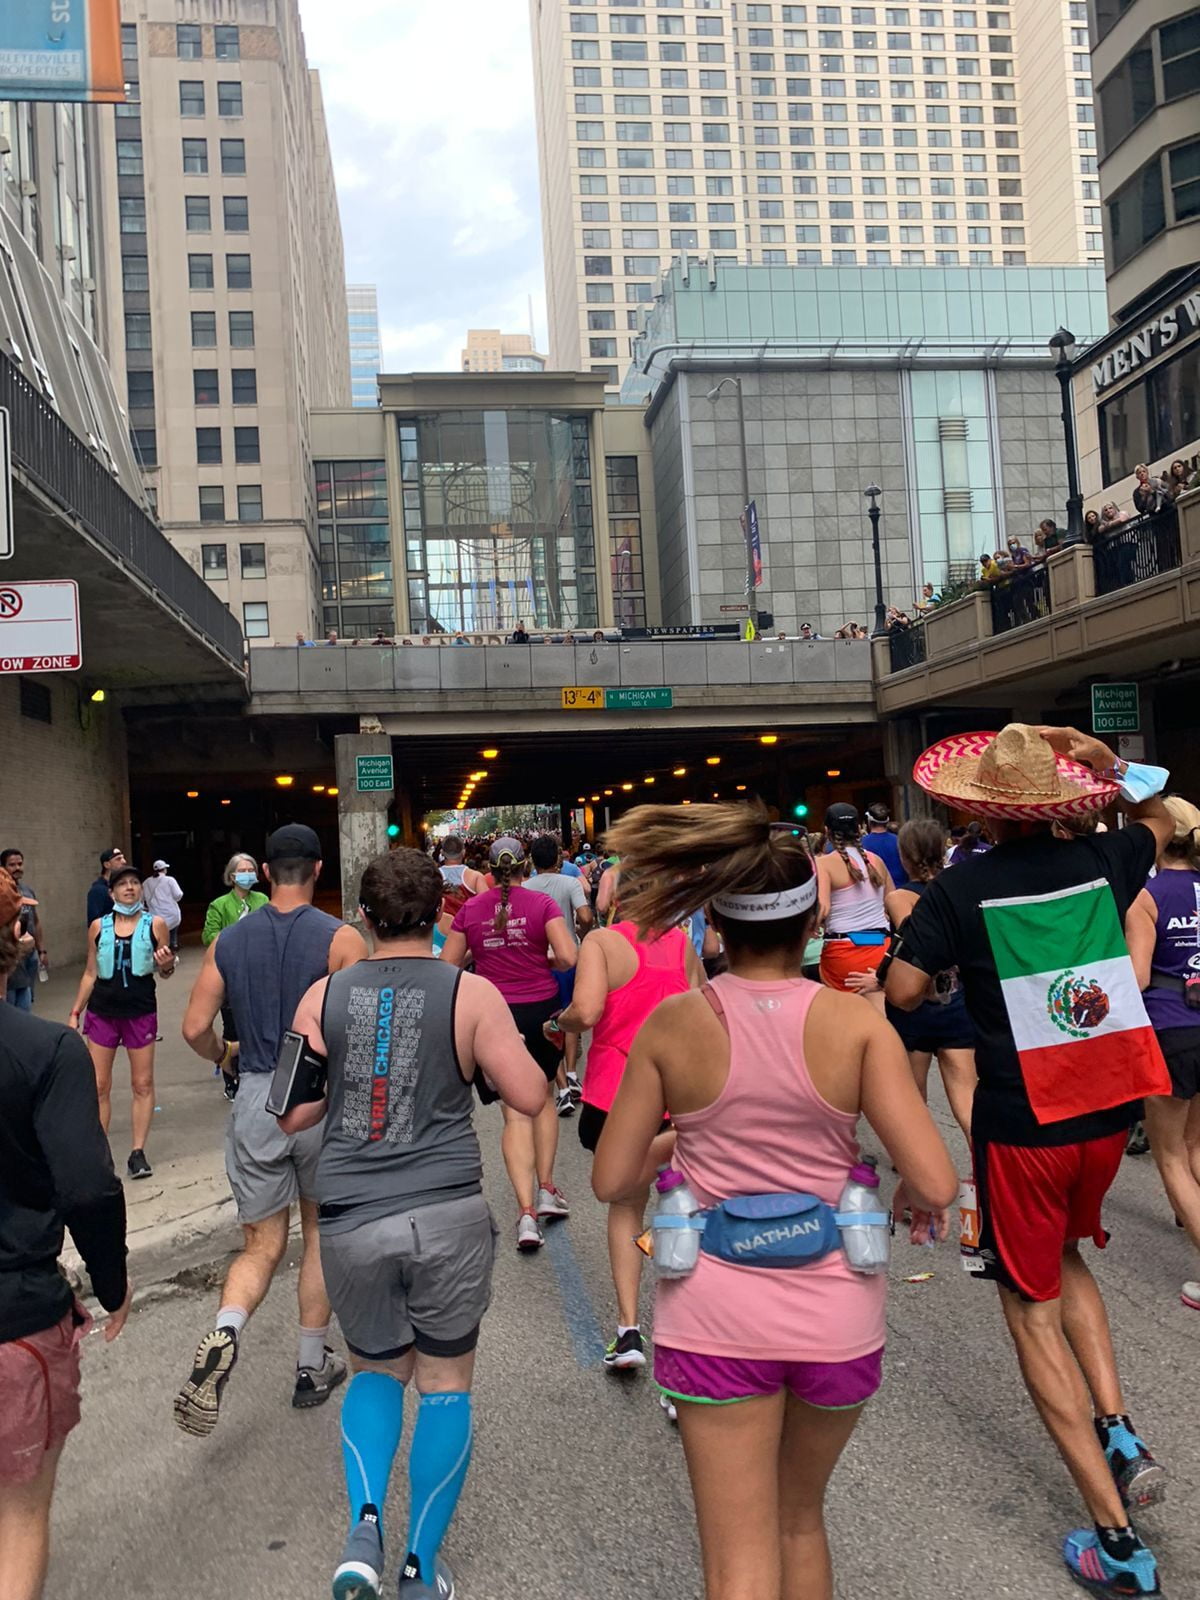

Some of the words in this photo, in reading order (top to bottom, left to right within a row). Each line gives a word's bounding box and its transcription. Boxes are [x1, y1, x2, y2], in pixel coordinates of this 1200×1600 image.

[1091, 311, 1179, 393] MEN'S
[646, 626, 715, 635] NEWSPAPERS
[1, 658, 24, 671] OW
[32, 656, 72, 669] ZONE
[619, 691, 657, 700] MICHIGAN
[1095, 689, 1136, 700] Michigan
[1099, 700, 1133, 709] Avenue
[1098, 718, 1114, 728] 100
[1116, 717, 1135, 727] East
[359, 760, 391, 768] Michigan
[360, 780, 374, 788] 100
[373, 987, 394, 1076] CHICAGO
[371, 1076, 388, 1120] RUN
[733, 1218, 821, 1253] NATHAN
